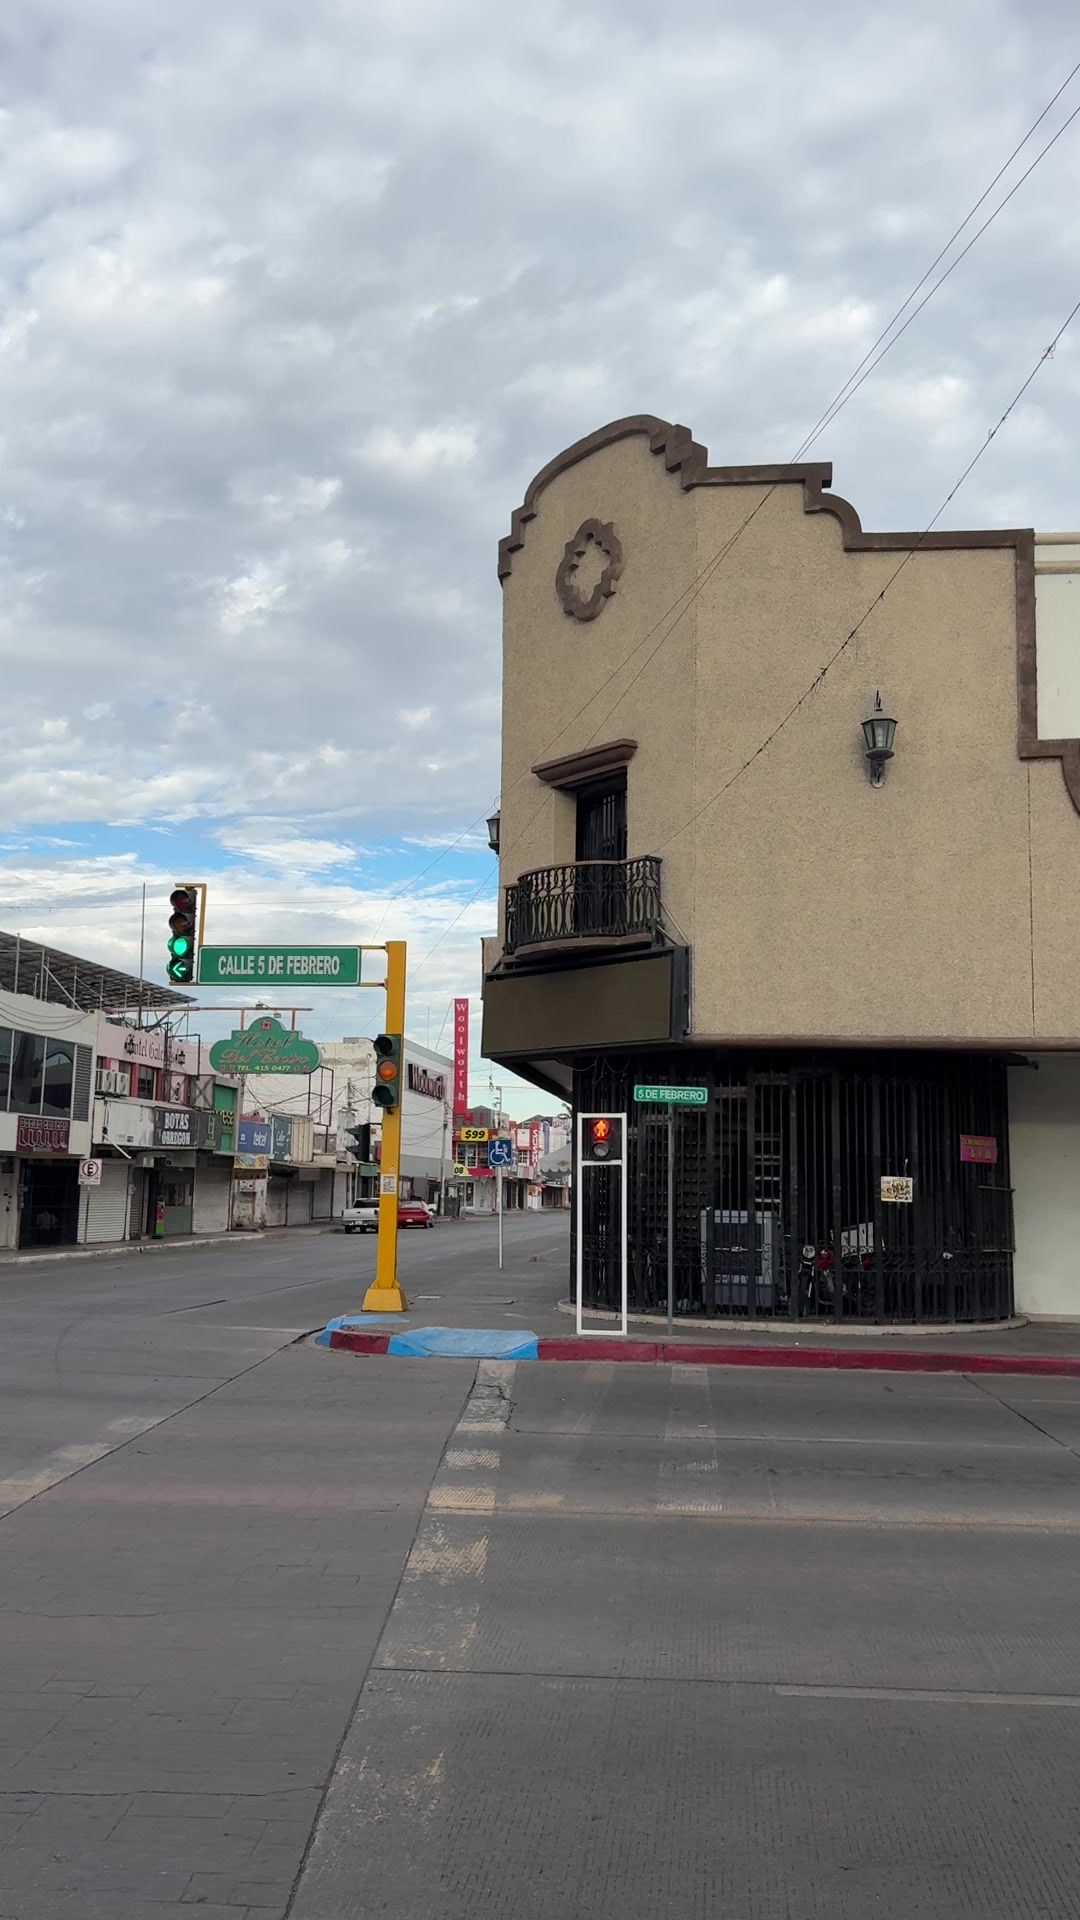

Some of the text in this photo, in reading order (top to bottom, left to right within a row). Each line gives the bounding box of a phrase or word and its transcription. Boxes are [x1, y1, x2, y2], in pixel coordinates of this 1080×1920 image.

[218, 955, 341, 976] CALLE 5 DE FEBRERO
[455, 1003, 467, 1101] Woolworth
[638, 1089, 704, 1100] 5 DE FEBRERO
[164, 1112, 189, 1130] BOTAS
[253, 1131, 268, 1147] telcel
[465, 1129, 485, 1139] $99
[87, 1163, 94, 1175] E
